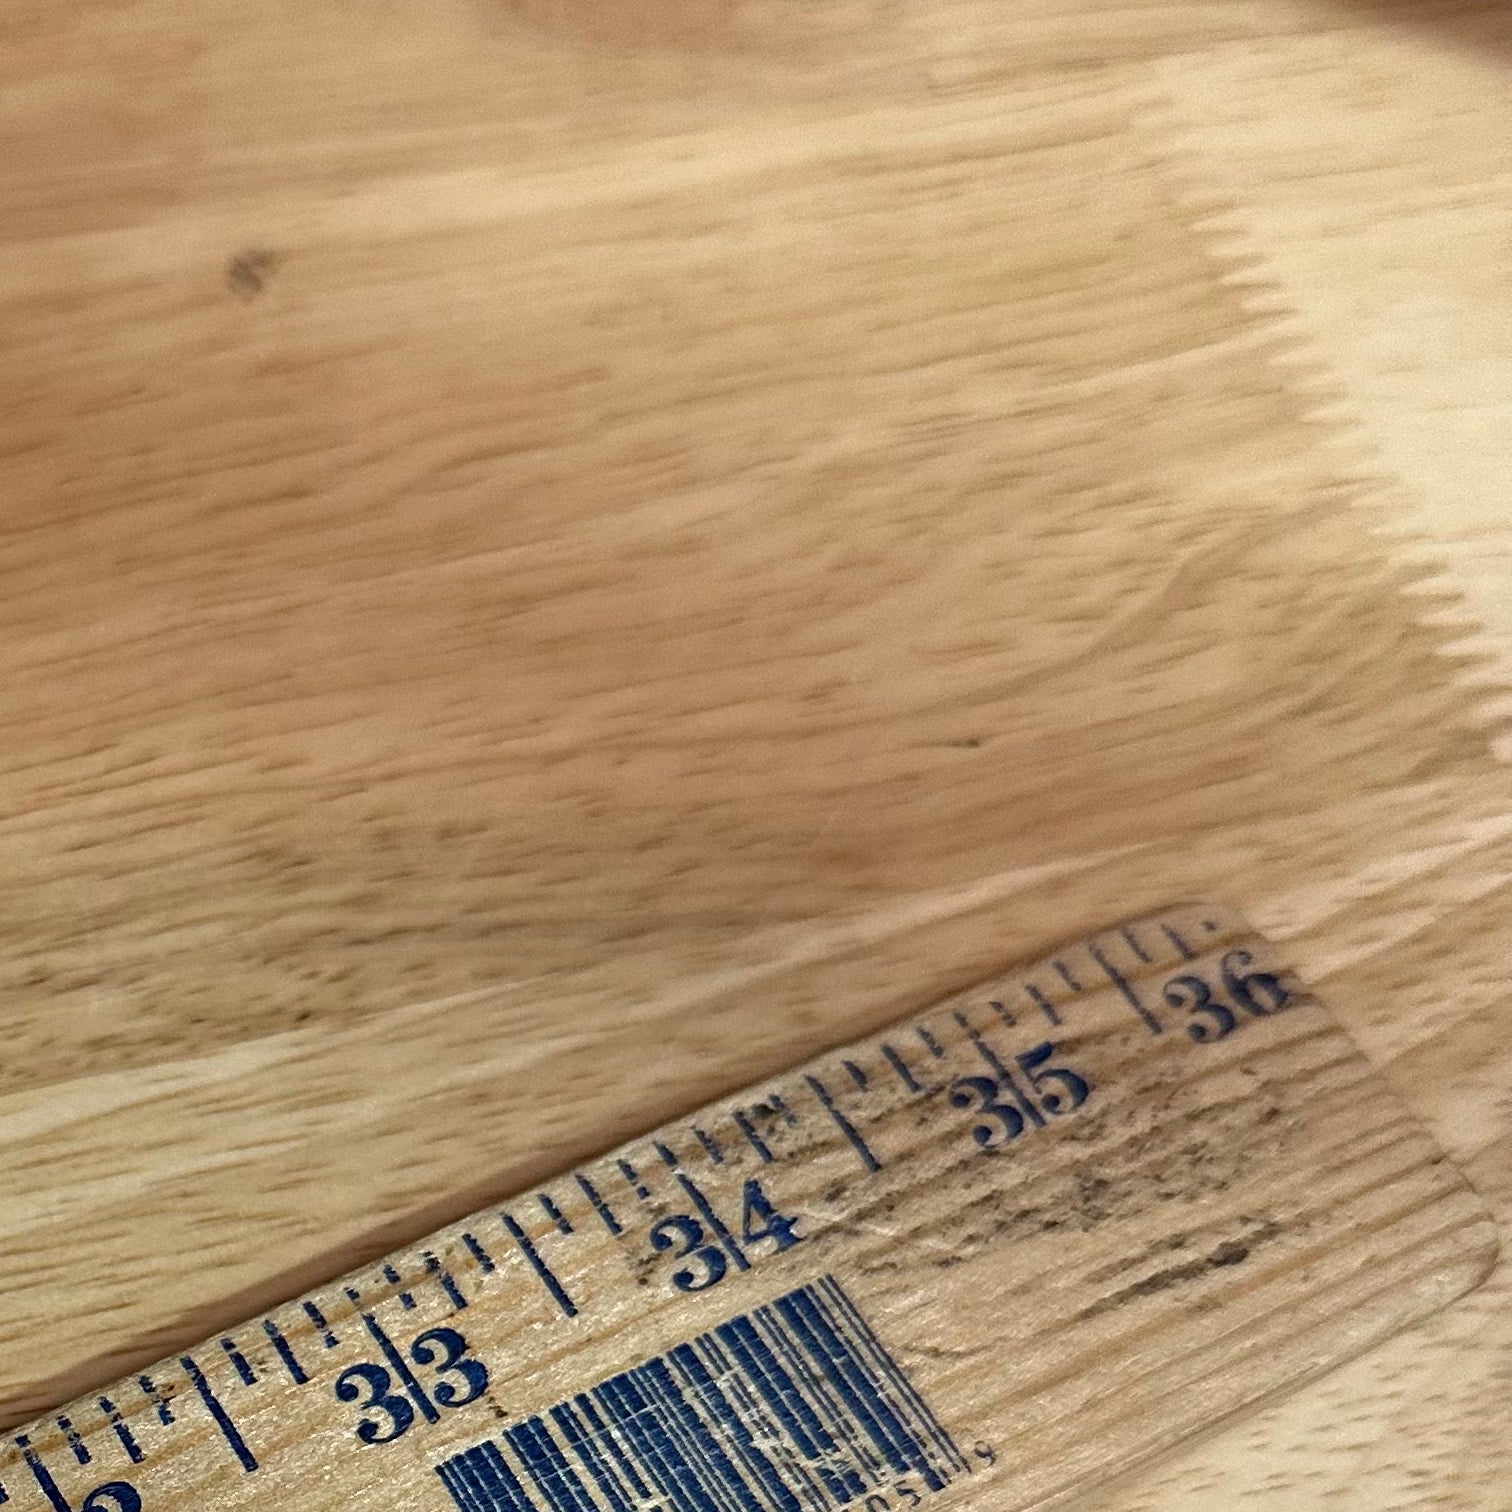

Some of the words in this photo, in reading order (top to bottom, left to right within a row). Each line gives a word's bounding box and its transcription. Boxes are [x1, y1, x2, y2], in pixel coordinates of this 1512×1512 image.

[1163, 950, 1289, 1044] 36
[948, 1041, 1091, 1149] 35
[650, 1179, 804, 1292] 34
[335, 1327, 488, 1446] 33
